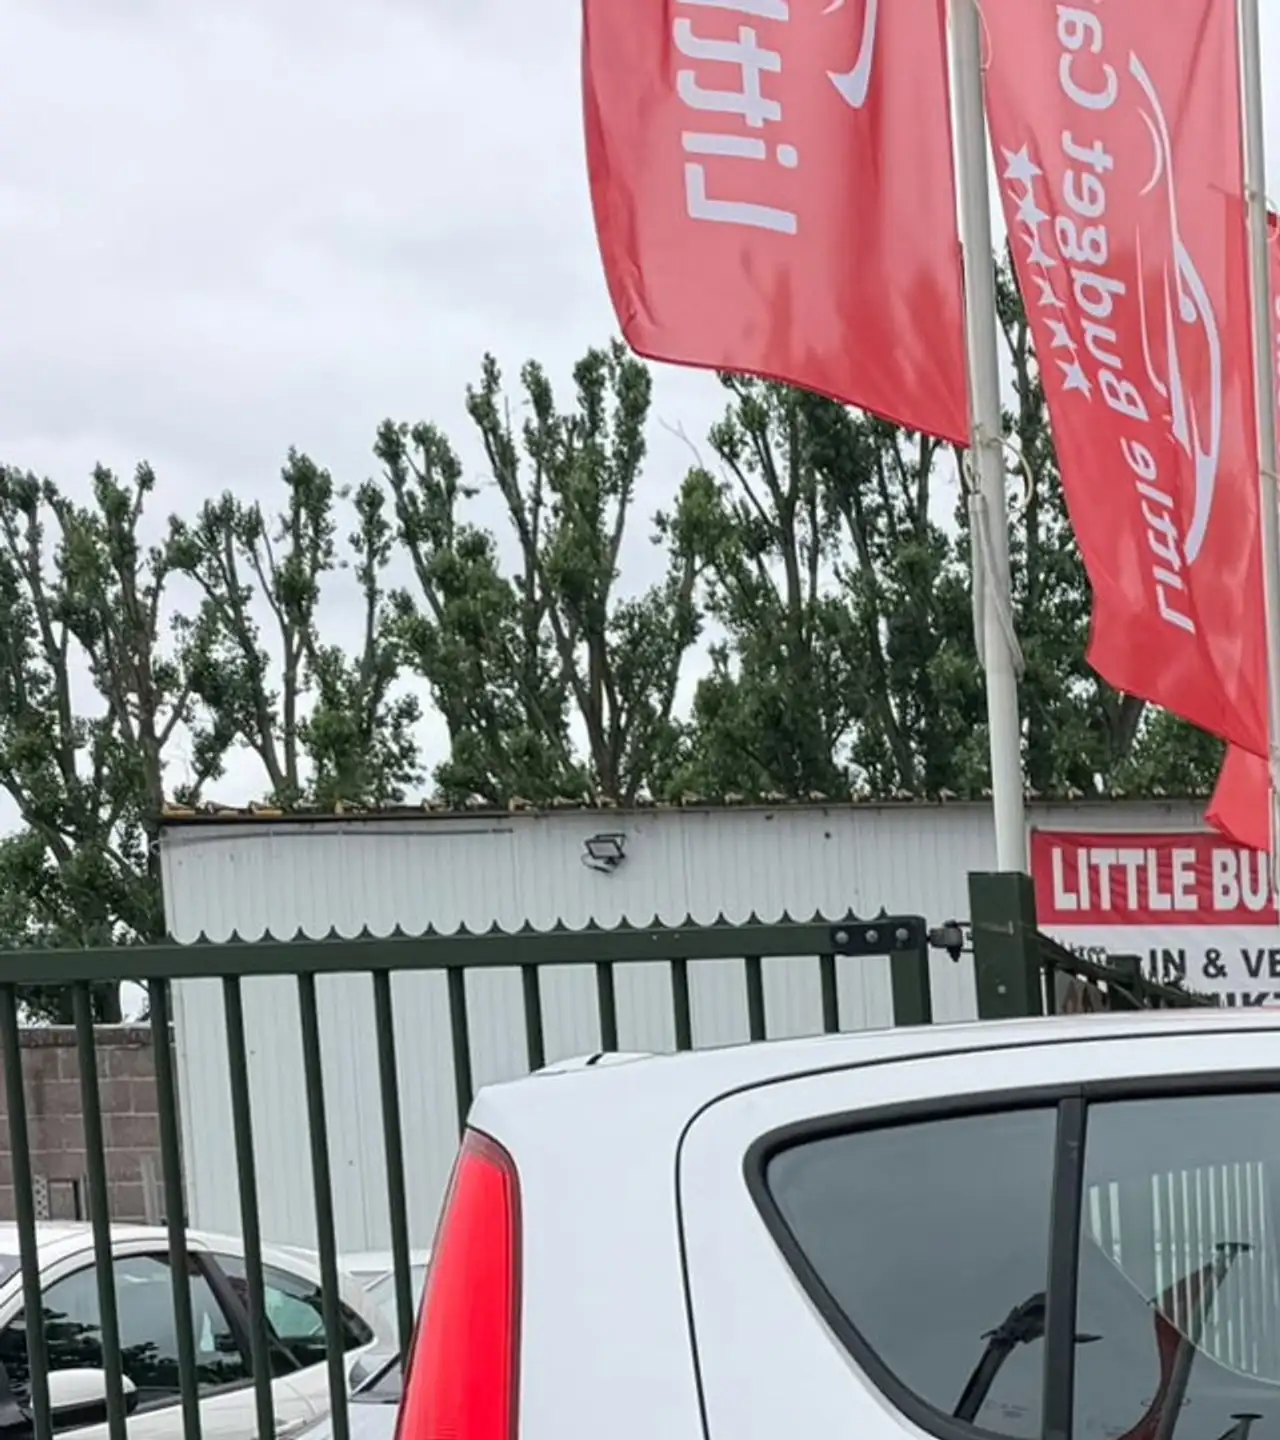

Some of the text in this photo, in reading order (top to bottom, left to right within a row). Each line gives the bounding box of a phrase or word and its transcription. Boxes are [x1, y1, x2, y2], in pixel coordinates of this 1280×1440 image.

[1052, 848, 1198, 911] LITTLE
[1150, 948, 1186, 979] IN
[1202, 948, 1228, 978] &
